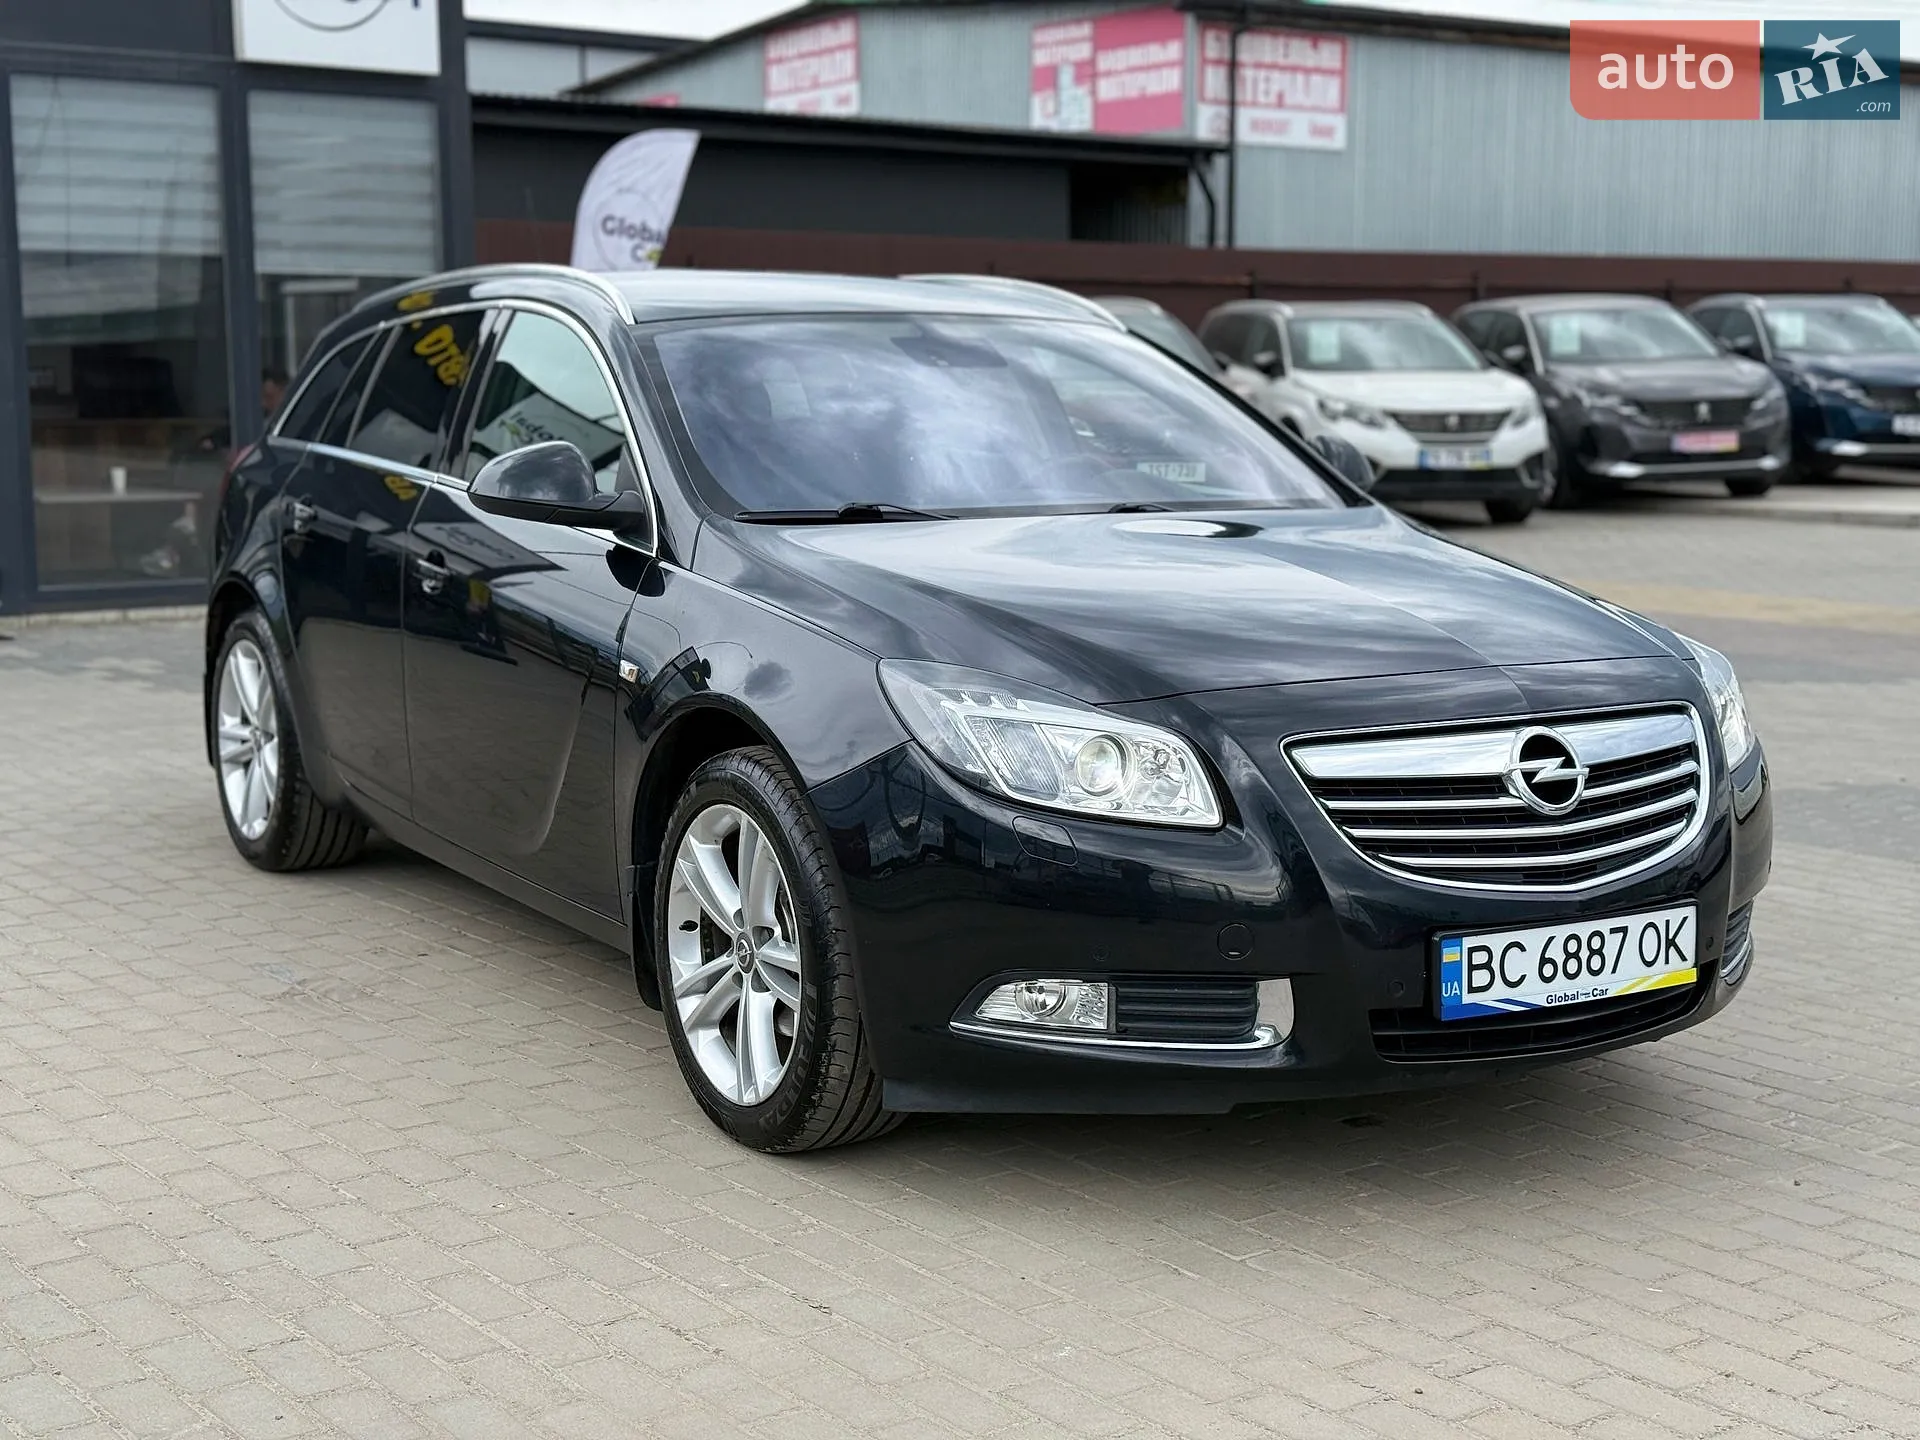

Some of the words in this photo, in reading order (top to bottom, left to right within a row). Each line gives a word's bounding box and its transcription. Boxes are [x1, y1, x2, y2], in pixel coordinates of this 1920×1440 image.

[1467, 940, 1528, 995] BC
[1538, 925, 1629, 984] 6887
[1638, 915, 1689, 968] OK
[1442, 981, 1461, 998] UA
[1546, 991, 1580, 1005] Global
[1591, 987, 1609, 998] Car
